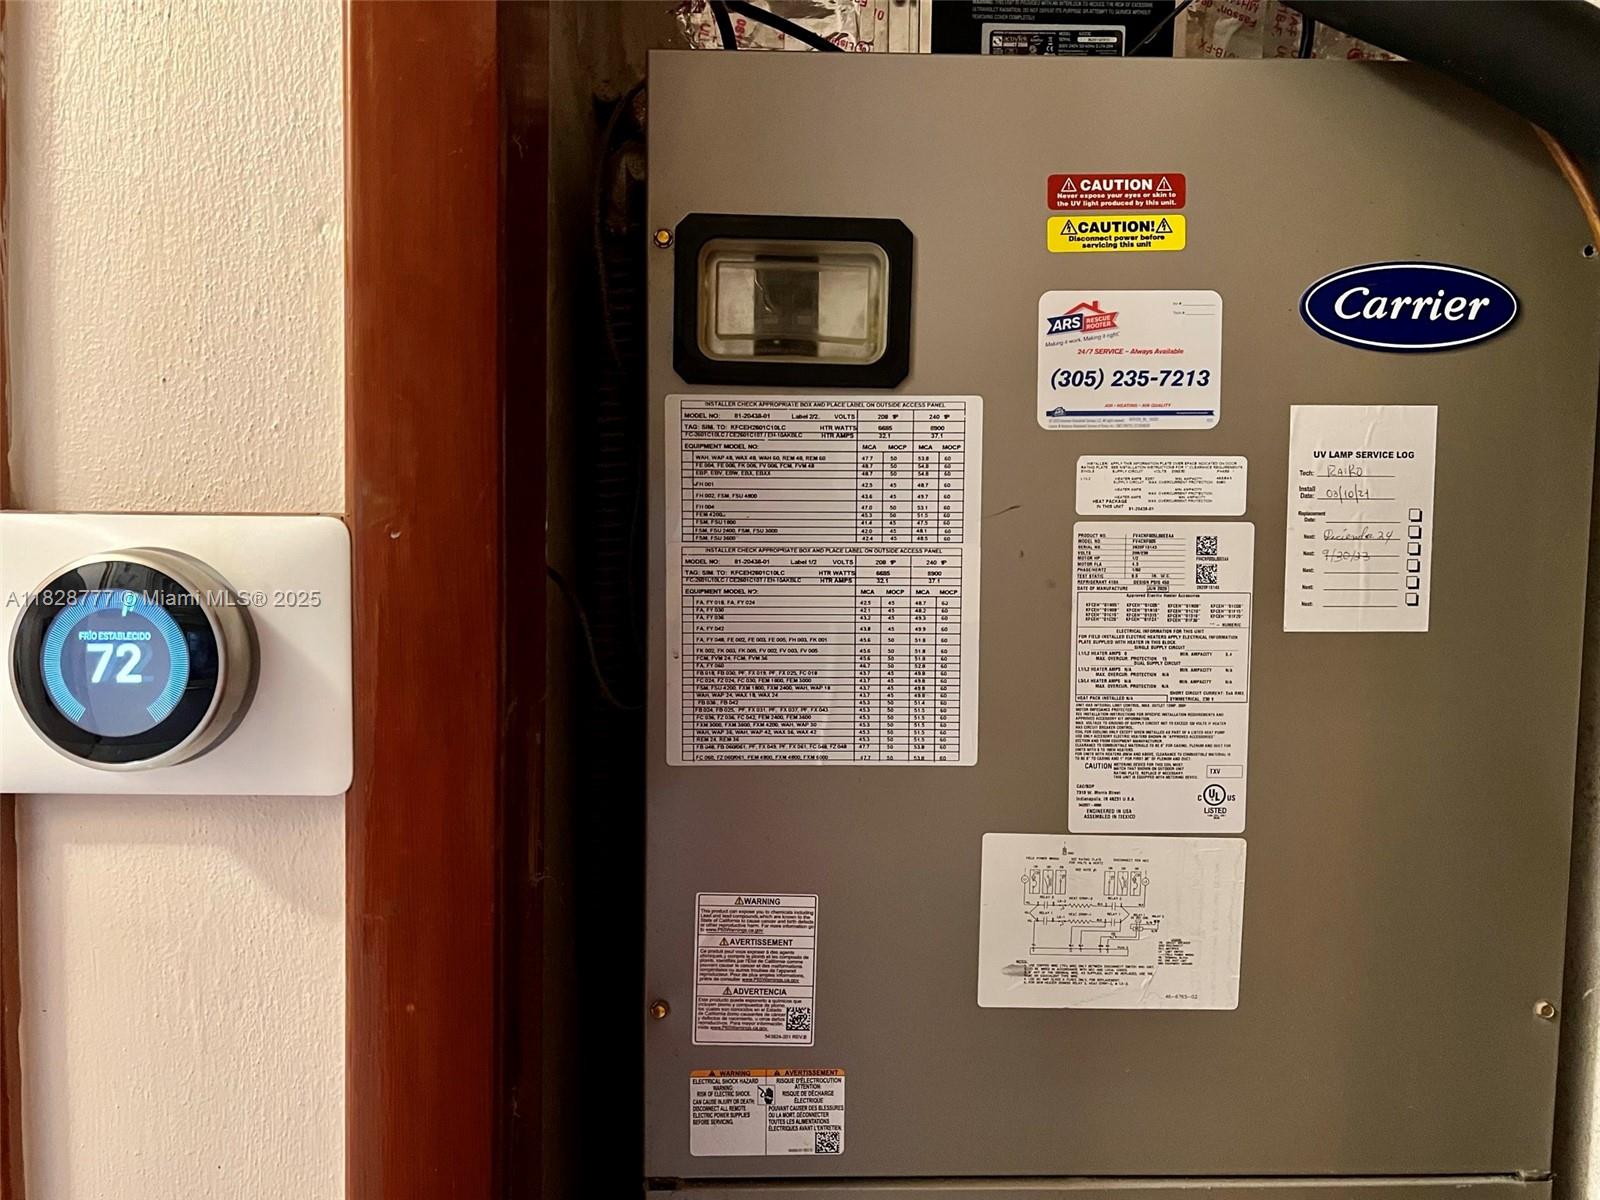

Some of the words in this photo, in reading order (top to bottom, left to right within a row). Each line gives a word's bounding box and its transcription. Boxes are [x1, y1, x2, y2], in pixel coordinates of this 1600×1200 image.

[1080, 179, 1152, 191] CAUTION
[1078, 221, 1155, 233] CAUTION!
[1334, 286, 1490, 320] Carrier
[1052, 317, 1080, 332] ARS
[1086, 315, 1110, 323] RESCUE
[1086, 321, 1111, 330] ROOTER
[1051, 368, 1104, 390] (305)
[1111, 369, 1210, 387] 235-7213
[79, 631, 97, 640] FRÍO
[98, 632, 151, 640] ESTABLECIDO
[86, 643, 142, 683] 72
